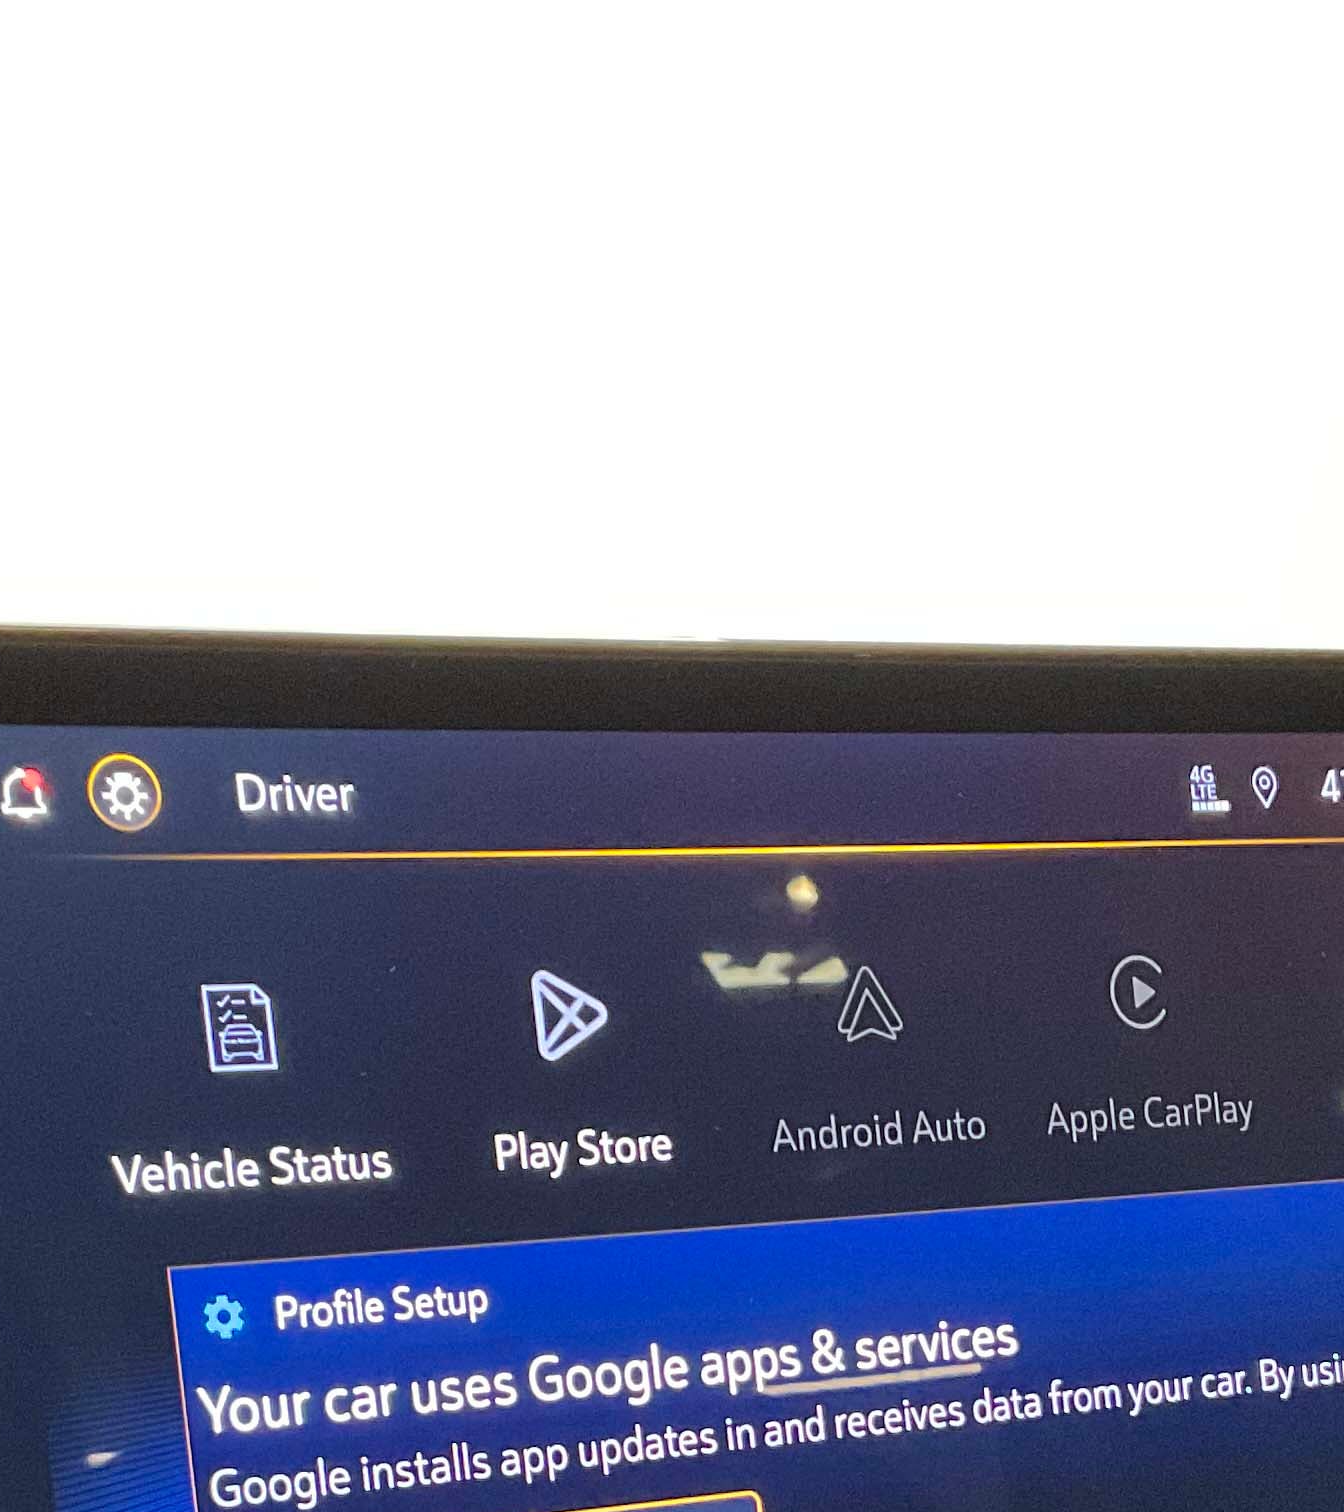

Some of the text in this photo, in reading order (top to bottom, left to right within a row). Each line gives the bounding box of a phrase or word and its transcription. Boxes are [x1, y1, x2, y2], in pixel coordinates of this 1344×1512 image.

[236, 773, 354, 813] Driver
[1189, 764, 1216, 784] 4G
[1190, 784, 1218, 801] LTE
[774, 1110, 985, 1152] Android Auto
[1048, 1092, 1252, 1142] Apple CarPlay
[111, 1146, 392, 1193] Vehicle Status
[495, 1129, 672, 1178] Play Store
[275, 1286, 488, 1330] Profile Setup
[196, 1321, 1018, 1434] Your car uses Google apps & services
[210, 1457, 351, 1510] Google
[361, 1442, 491, 1491] installs
[501, 1445, 568, 1484] app
[579, 1424, 718, 1475] updates
[726, 1418, 756, 1450] in
[765, 1405, 825, 1447] and
[835, 1400, 965, 1438] receives
[973, 1387, 1042, 1423] data
[1048, 1379, 1122, 1414] from
[1128, 1377, 1193, 1416] your
[1201, 1371, 1252, 1398] car.
[1260, 1359, 1294, 1399] By
